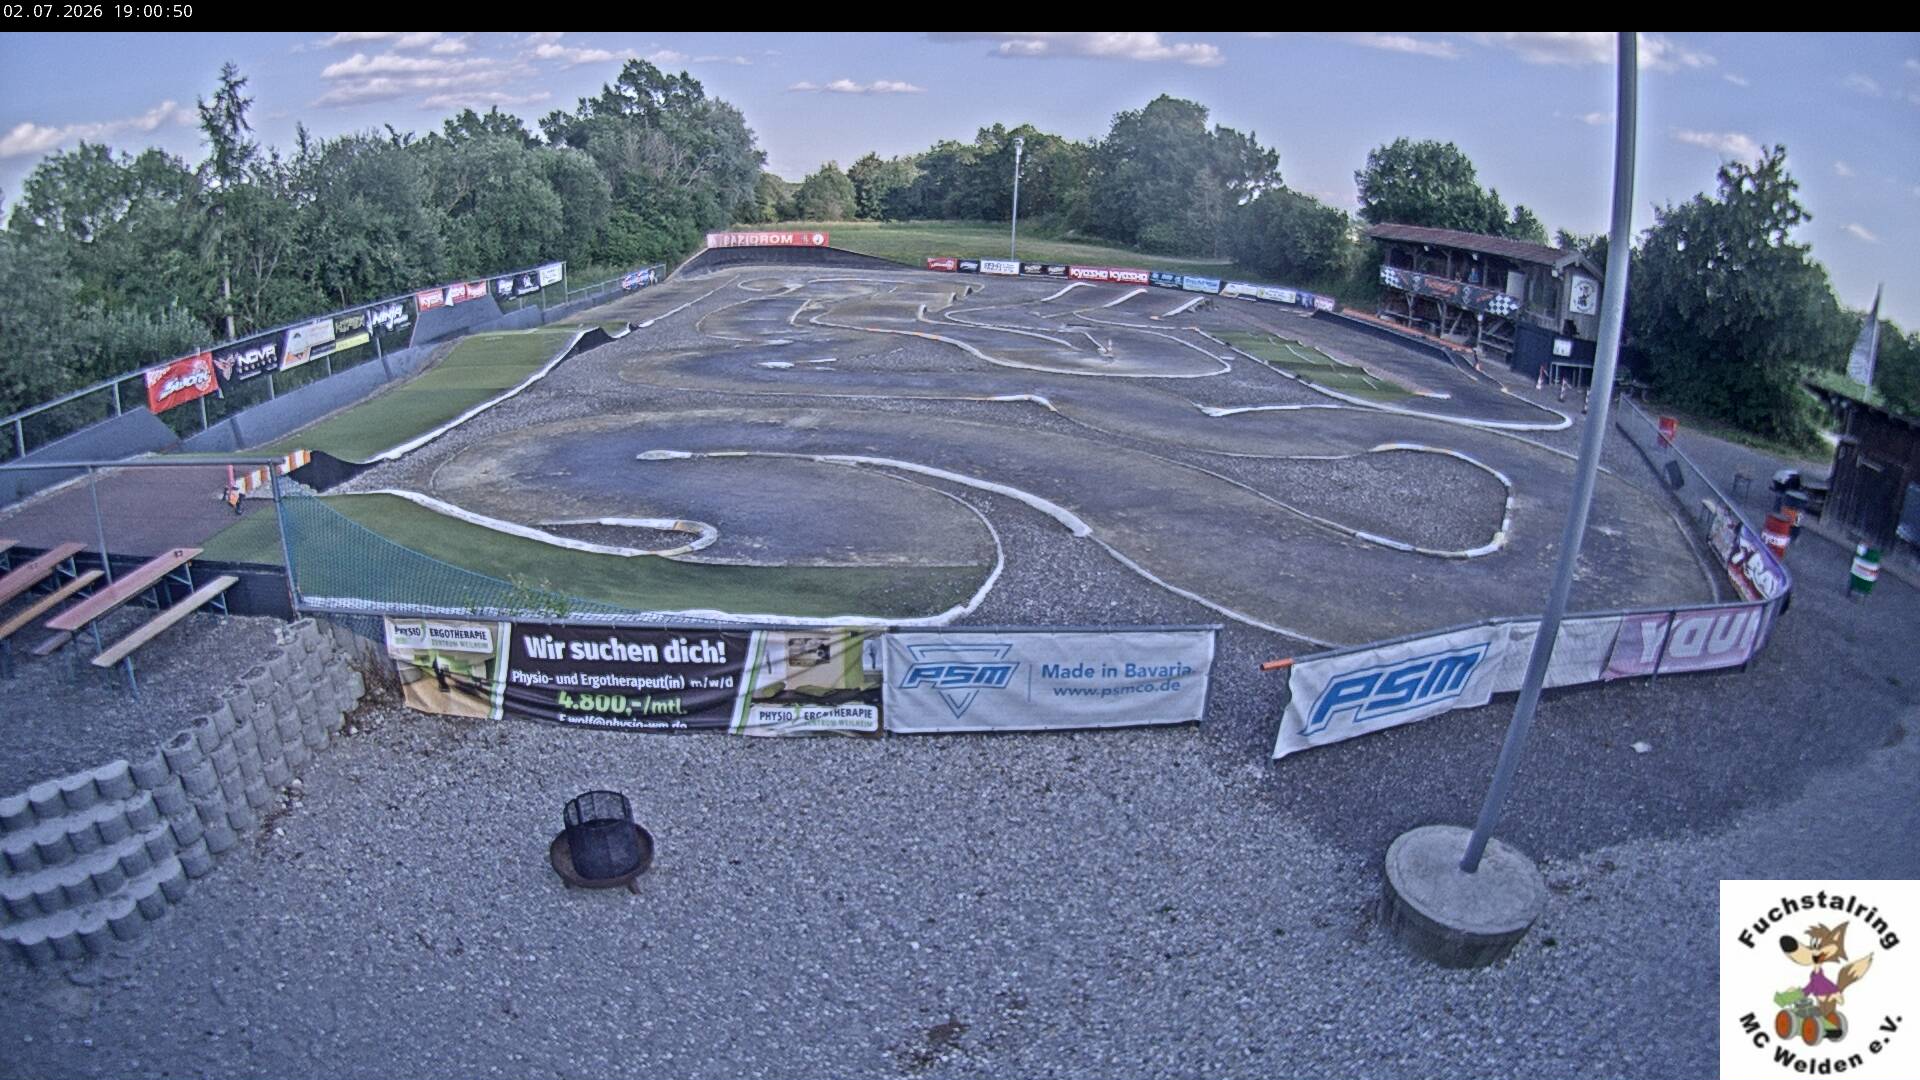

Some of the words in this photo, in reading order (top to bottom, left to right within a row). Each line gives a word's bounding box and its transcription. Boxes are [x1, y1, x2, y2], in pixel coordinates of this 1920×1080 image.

[524, 635, 566, 660] Wir
[571, 637, 659, 663] suchen
[664, 637, 727, 664] dich!
[512, 670, 553, 686] Physio-
[556, 673, 579, 686] und
[580, 673, 685, 690] Ergotherapeut(in)
[690, 676, 734, 688] m/w/d
[910, 664, 1012, 685] PSM
[1041, 663, 1094, 679] Made
[1101, 663, 1118, 678] in
[1127, 662, 1192, 678] Bavaria
[1053, 679, 1181, 698] www.psmco.de
[1310, 651, 1482, 726] PSM
[759, 710, 793, 721] PHYSIO
